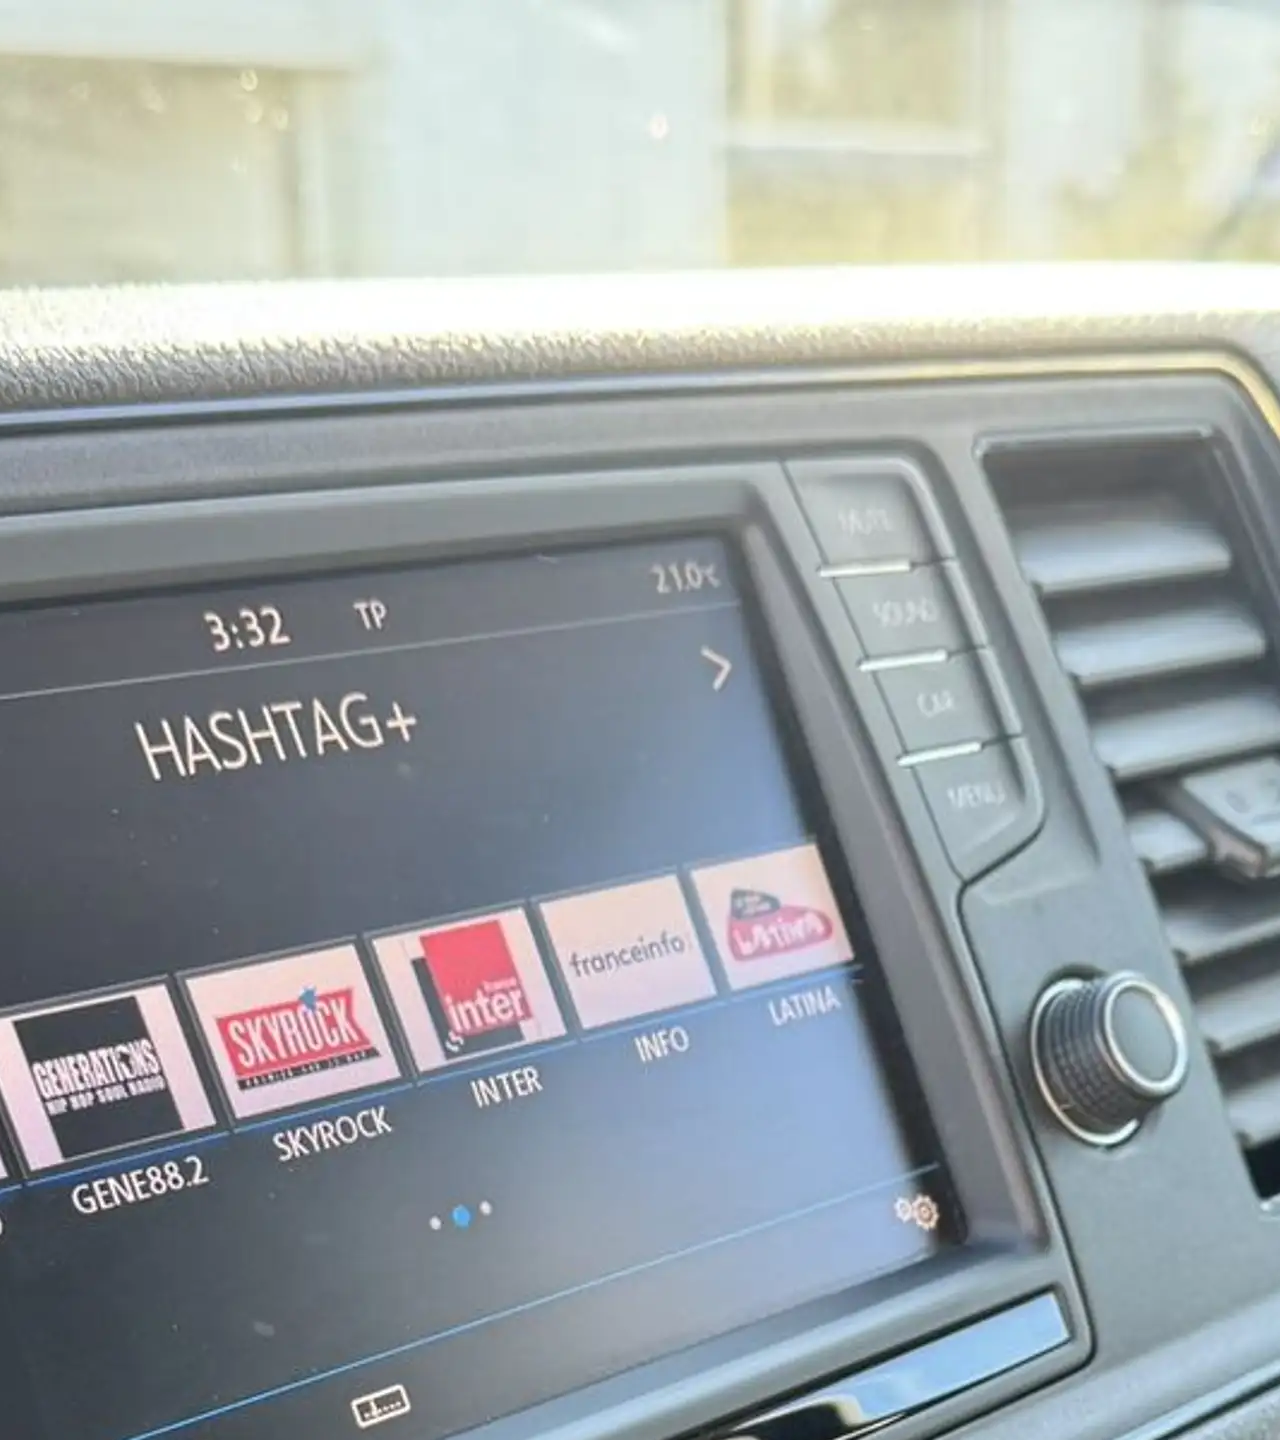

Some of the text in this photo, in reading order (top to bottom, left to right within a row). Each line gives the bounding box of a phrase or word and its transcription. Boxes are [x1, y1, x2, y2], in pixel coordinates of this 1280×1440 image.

[204, 606, 291, 652] 3:32
[353, 599, 388, 631] TP
[134, 692, 417, 781] HASHTAG+
[444, 988, 525, 1035] inter
[768, 985, 841, 1026] LATINA
[228, 997, 360, 1069] SKYROCK
[634, 1026, 690, 1063] INFO
[470, 1066, 544, 1108] INTER
[272, 1105, 393, 1162] SKYROCK
[72, 1155, 209, 1215] GENE88.2
